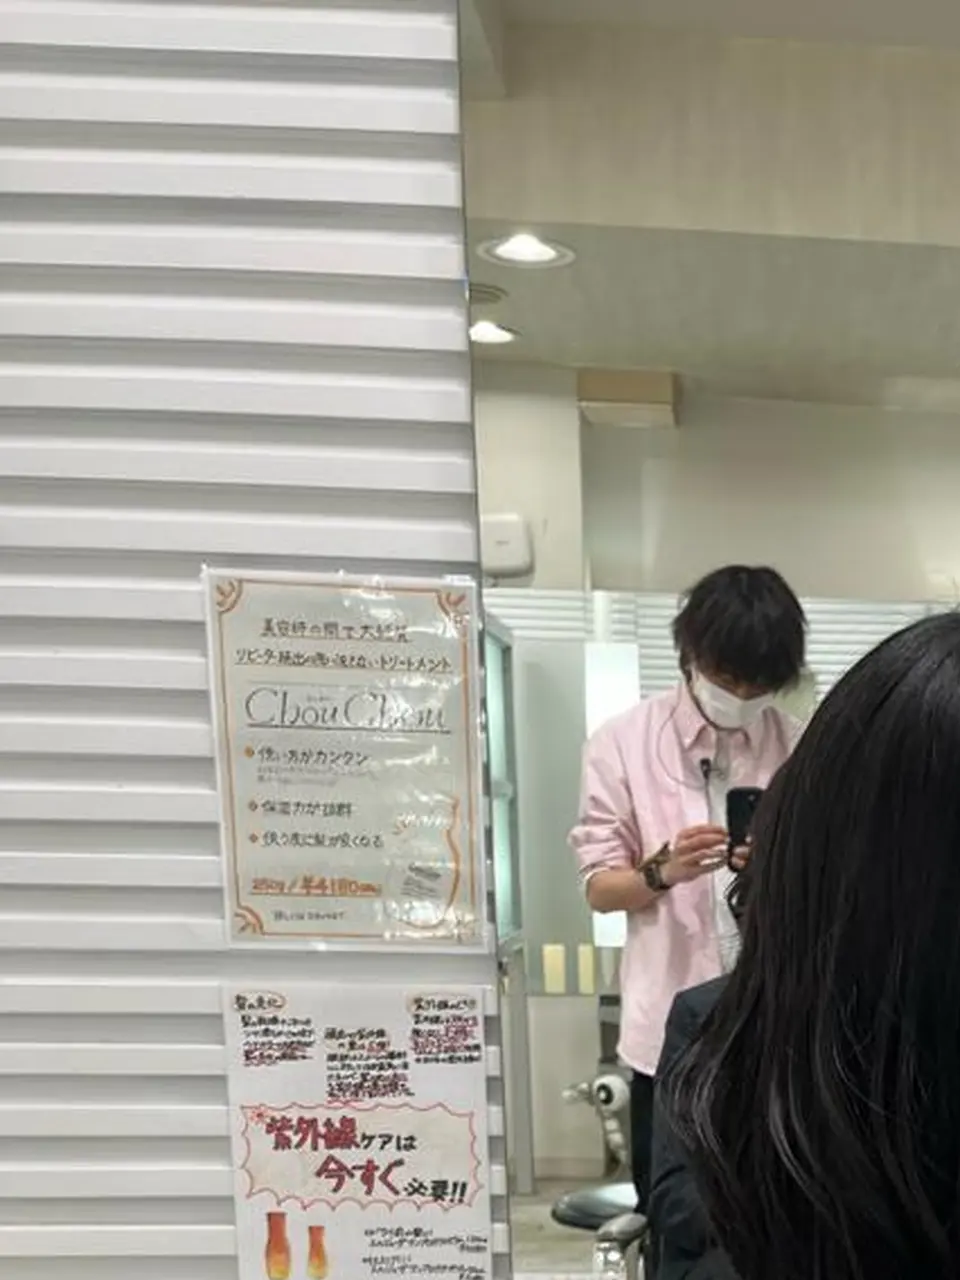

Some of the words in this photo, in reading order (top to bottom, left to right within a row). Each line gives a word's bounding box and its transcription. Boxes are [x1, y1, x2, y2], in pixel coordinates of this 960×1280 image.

[265, 1114, 418, 1152] 紫外線ケアは
